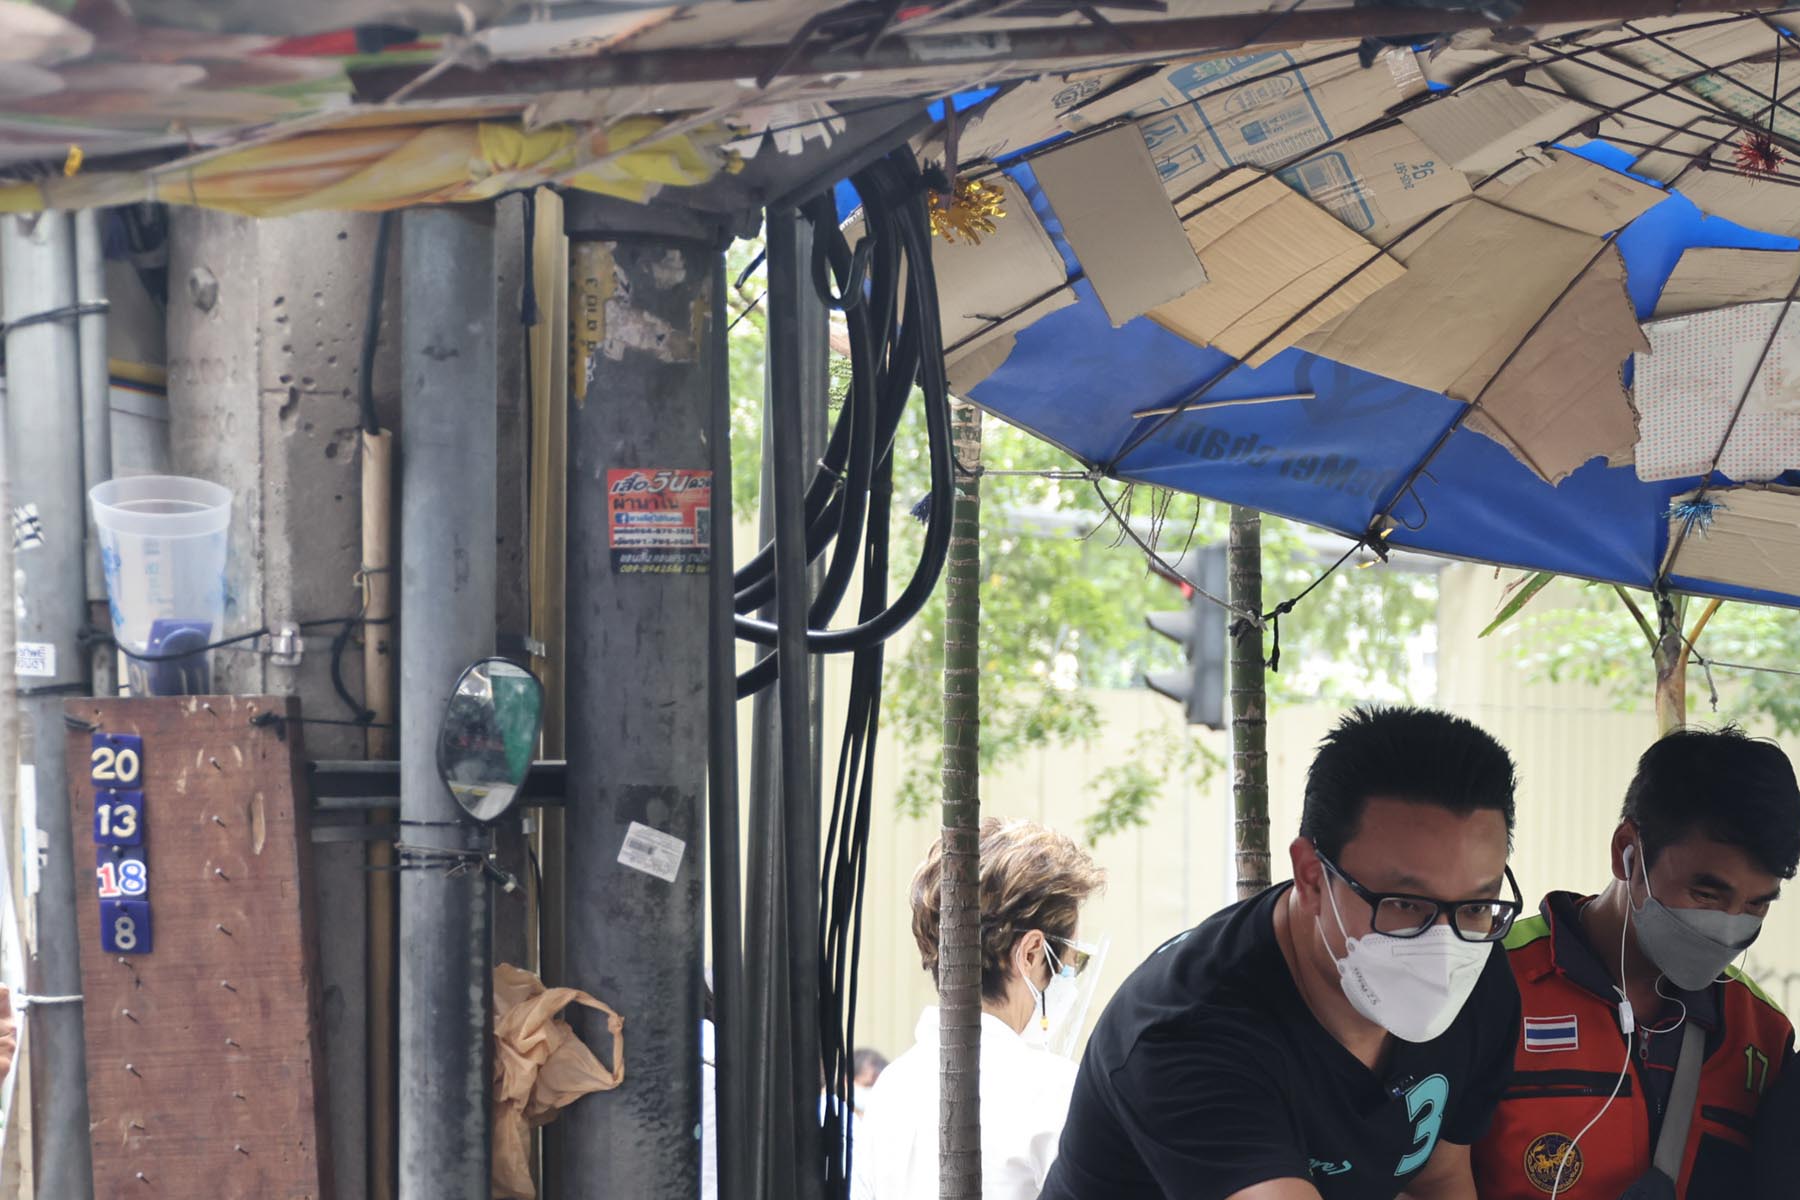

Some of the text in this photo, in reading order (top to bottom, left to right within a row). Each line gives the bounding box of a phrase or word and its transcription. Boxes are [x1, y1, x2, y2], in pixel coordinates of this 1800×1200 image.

[91, 747, 139, 782] 20
[98, 804, 137, 837] 13
[97, 859, 146, 896] 18
[115, 916, 136, 949] 8
[1394, 1073, 1449, 1177] 3
